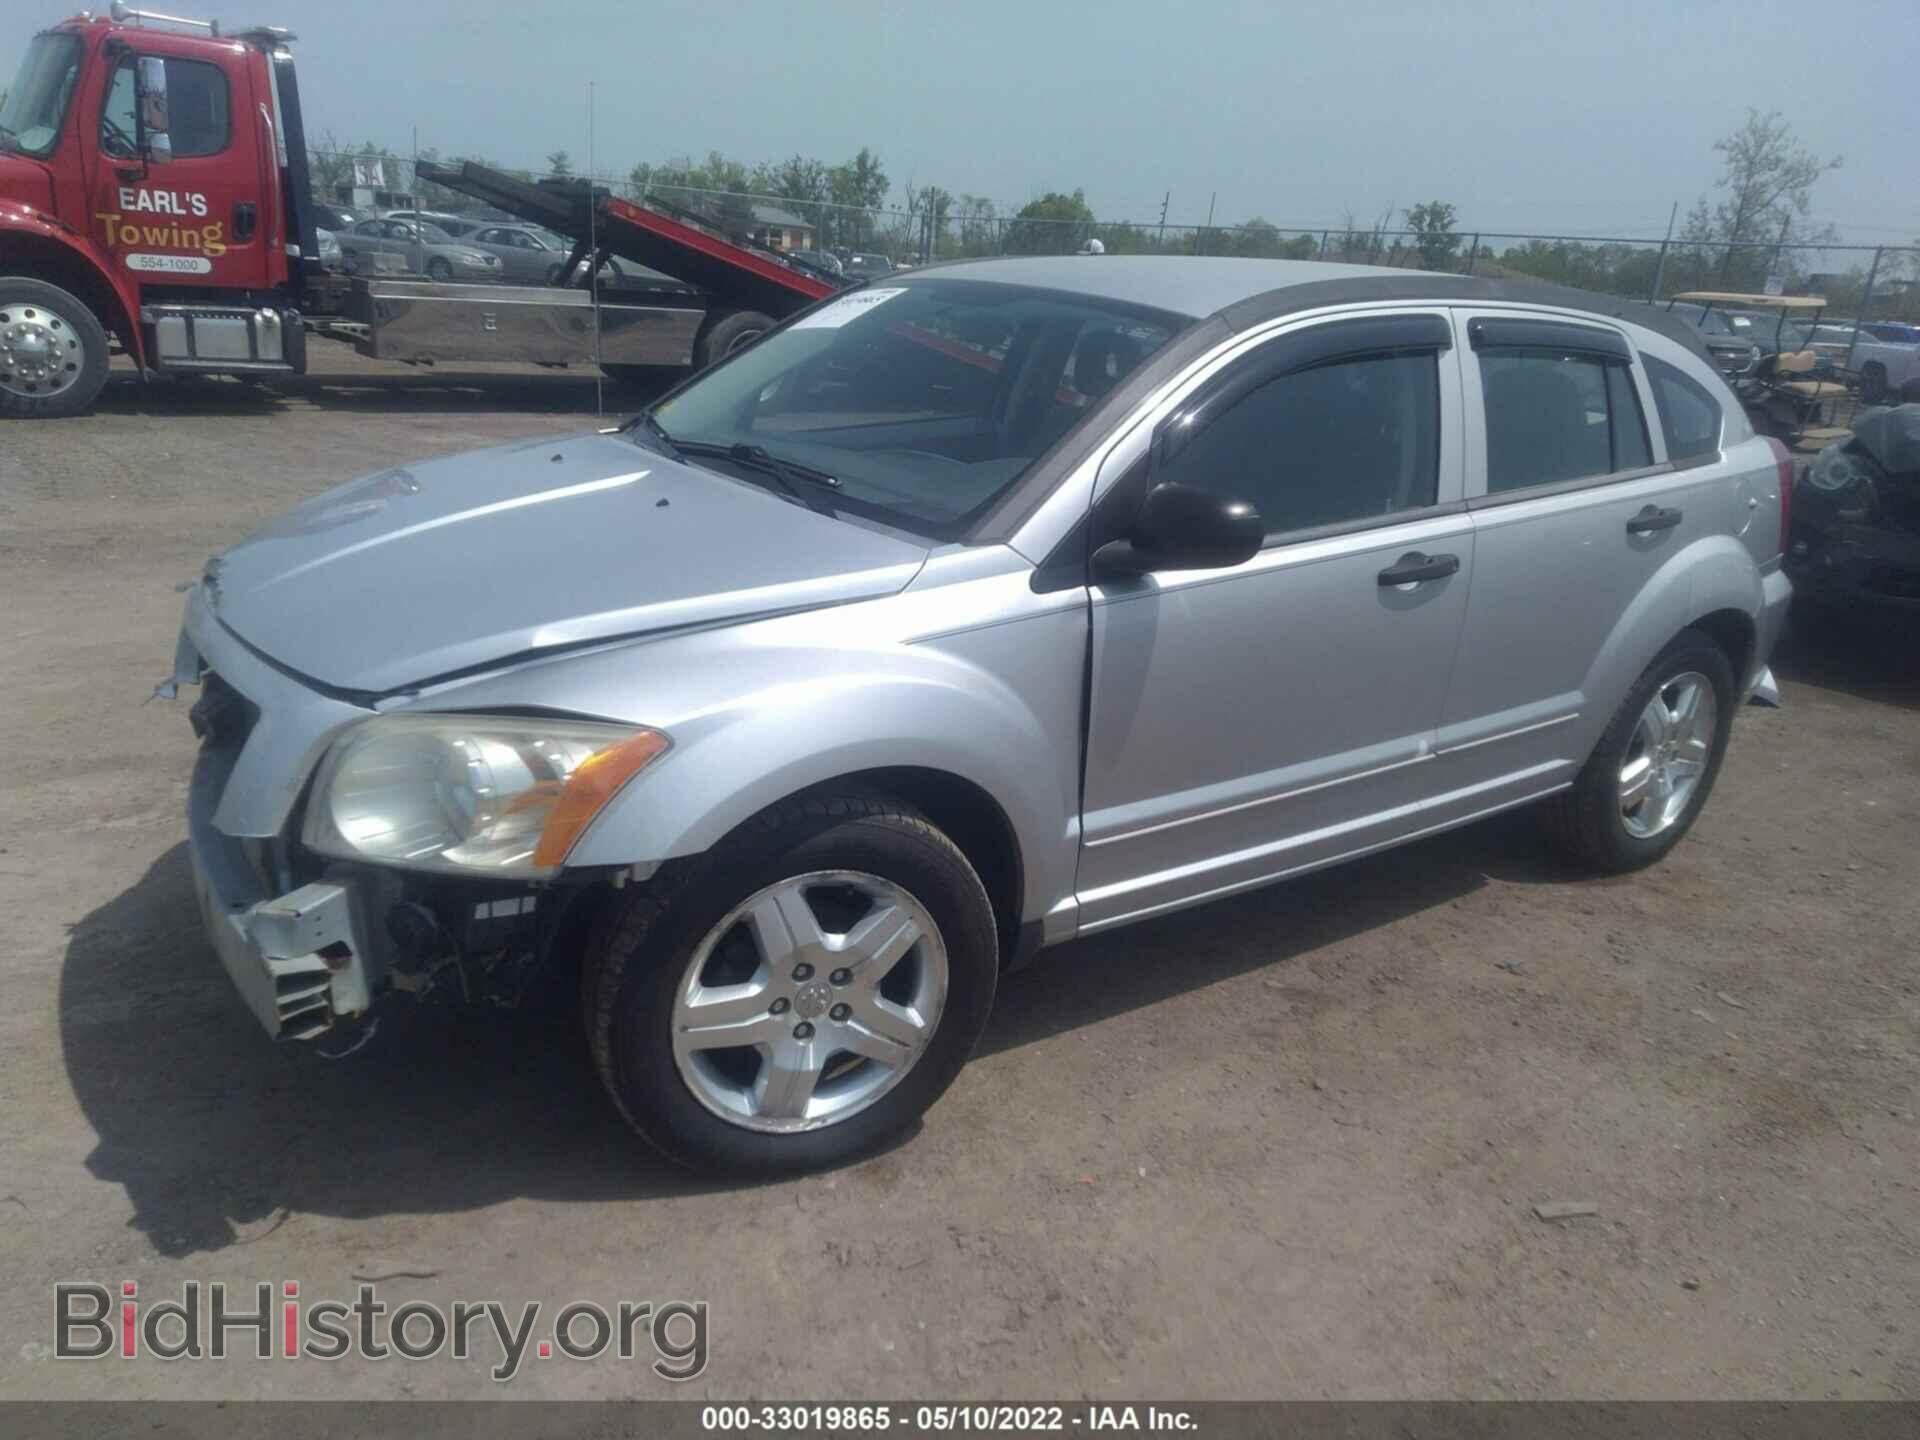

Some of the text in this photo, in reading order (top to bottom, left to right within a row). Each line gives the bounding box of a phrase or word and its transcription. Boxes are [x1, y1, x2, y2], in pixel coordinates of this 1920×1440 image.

[119, 187, 208, 216] EARL'S
[95, 213, 226, 256] Towing
[140, 256, 199, 271] 554-1000
